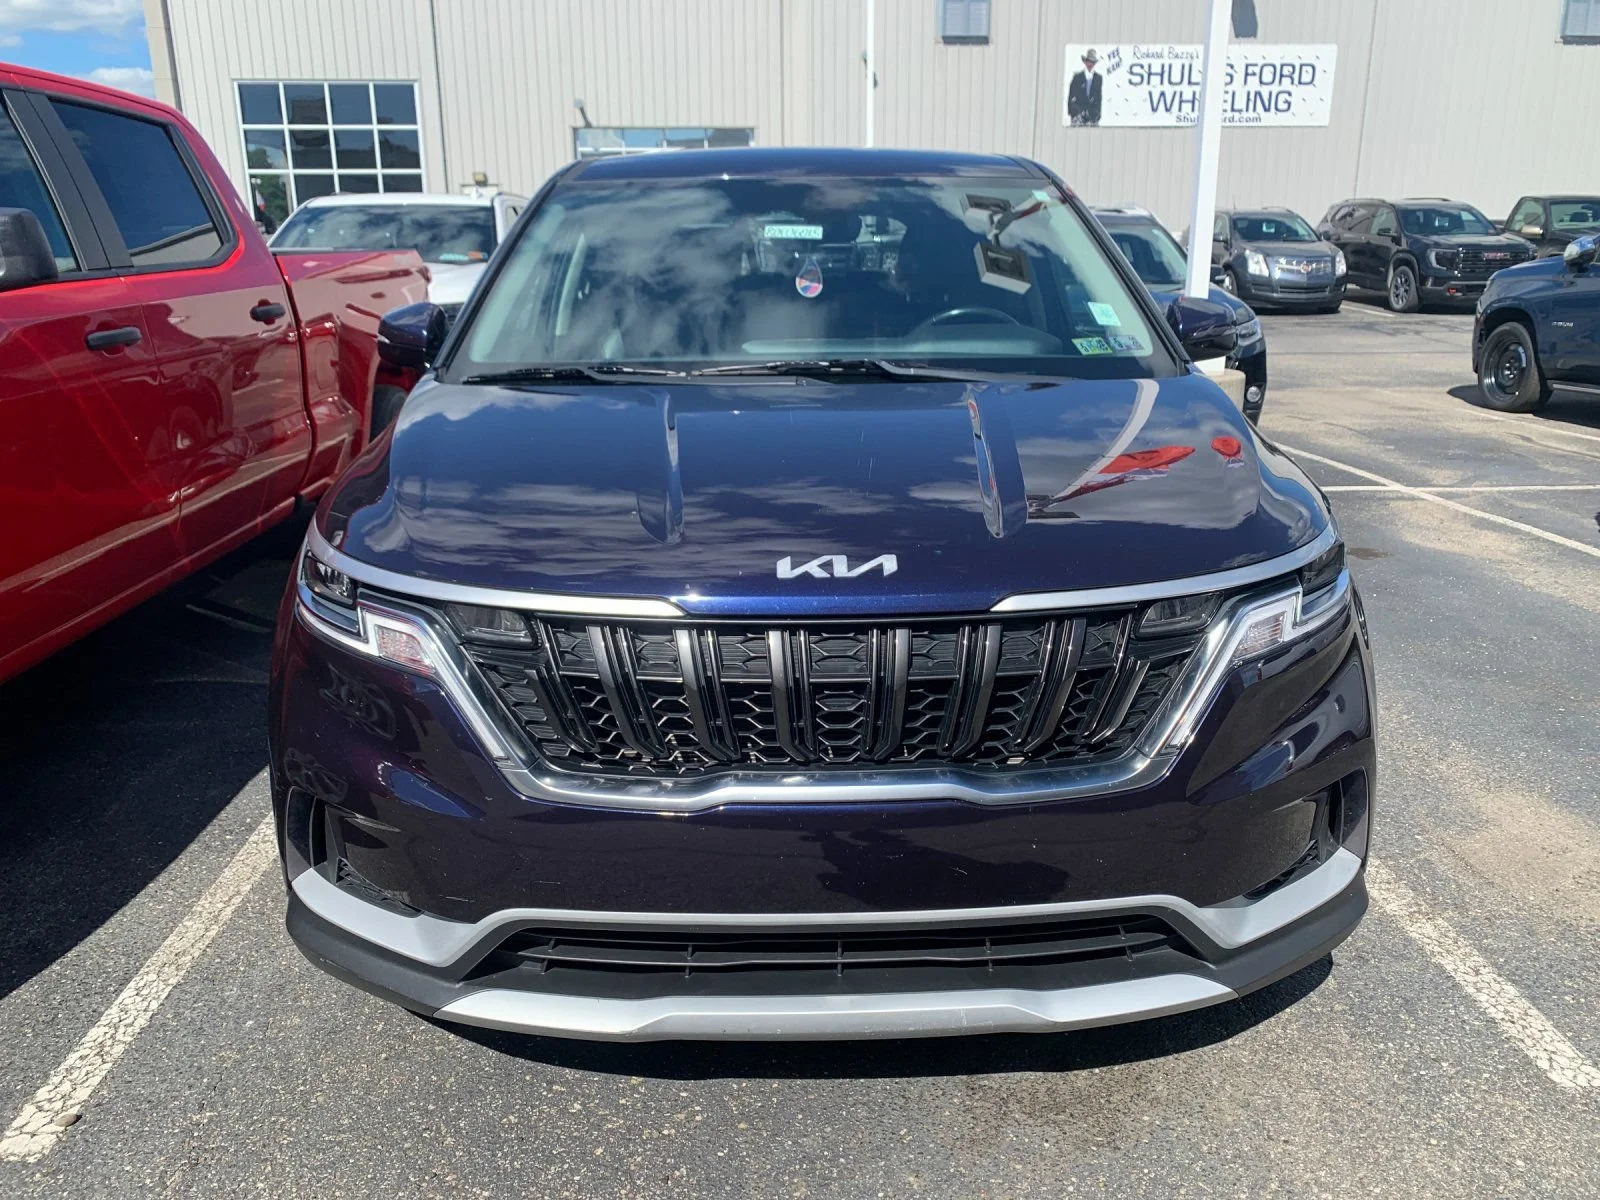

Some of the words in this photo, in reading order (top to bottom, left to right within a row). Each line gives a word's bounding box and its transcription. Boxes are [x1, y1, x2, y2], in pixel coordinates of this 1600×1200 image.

[1128, 63, 1234, 86] SHULS
[1244, 63, 1316, 86] FORD
[1148, 90, 1292, 112] WHLING
[776, 554, 898, 579] KIA
